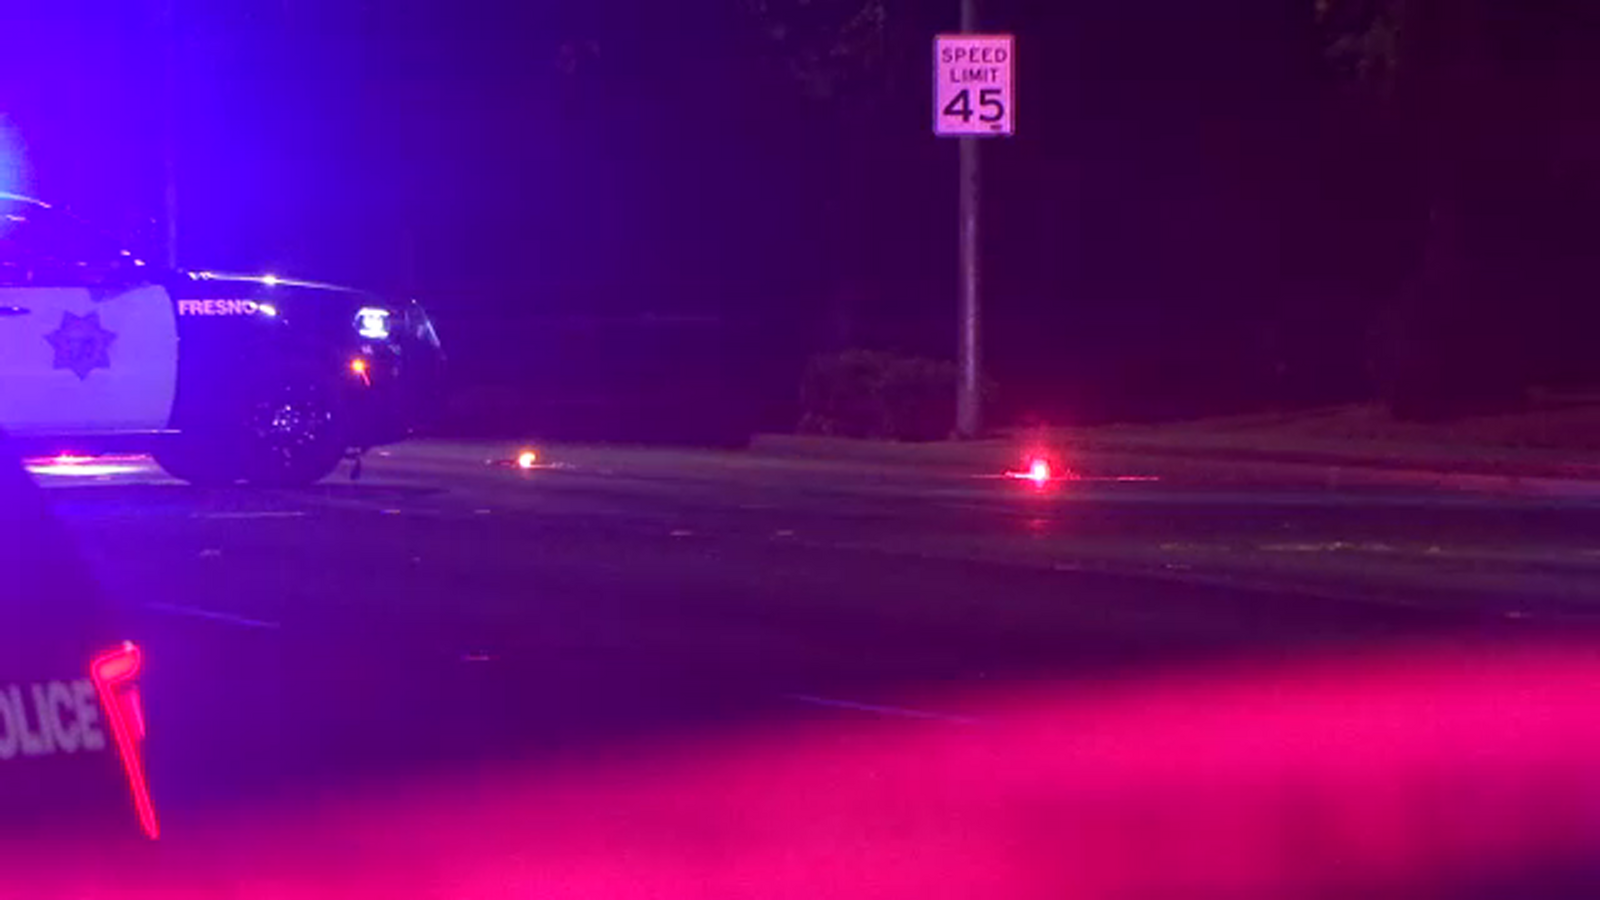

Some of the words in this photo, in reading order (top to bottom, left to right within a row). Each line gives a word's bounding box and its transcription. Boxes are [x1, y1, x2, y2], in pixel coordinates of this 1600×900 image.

[942, 47, 1007, 63] SPEED
[950, 69, 998, 82] LIMIT
[943, 88, 1005, 122] 45
[178, 299, 257, 316] FRESNO
